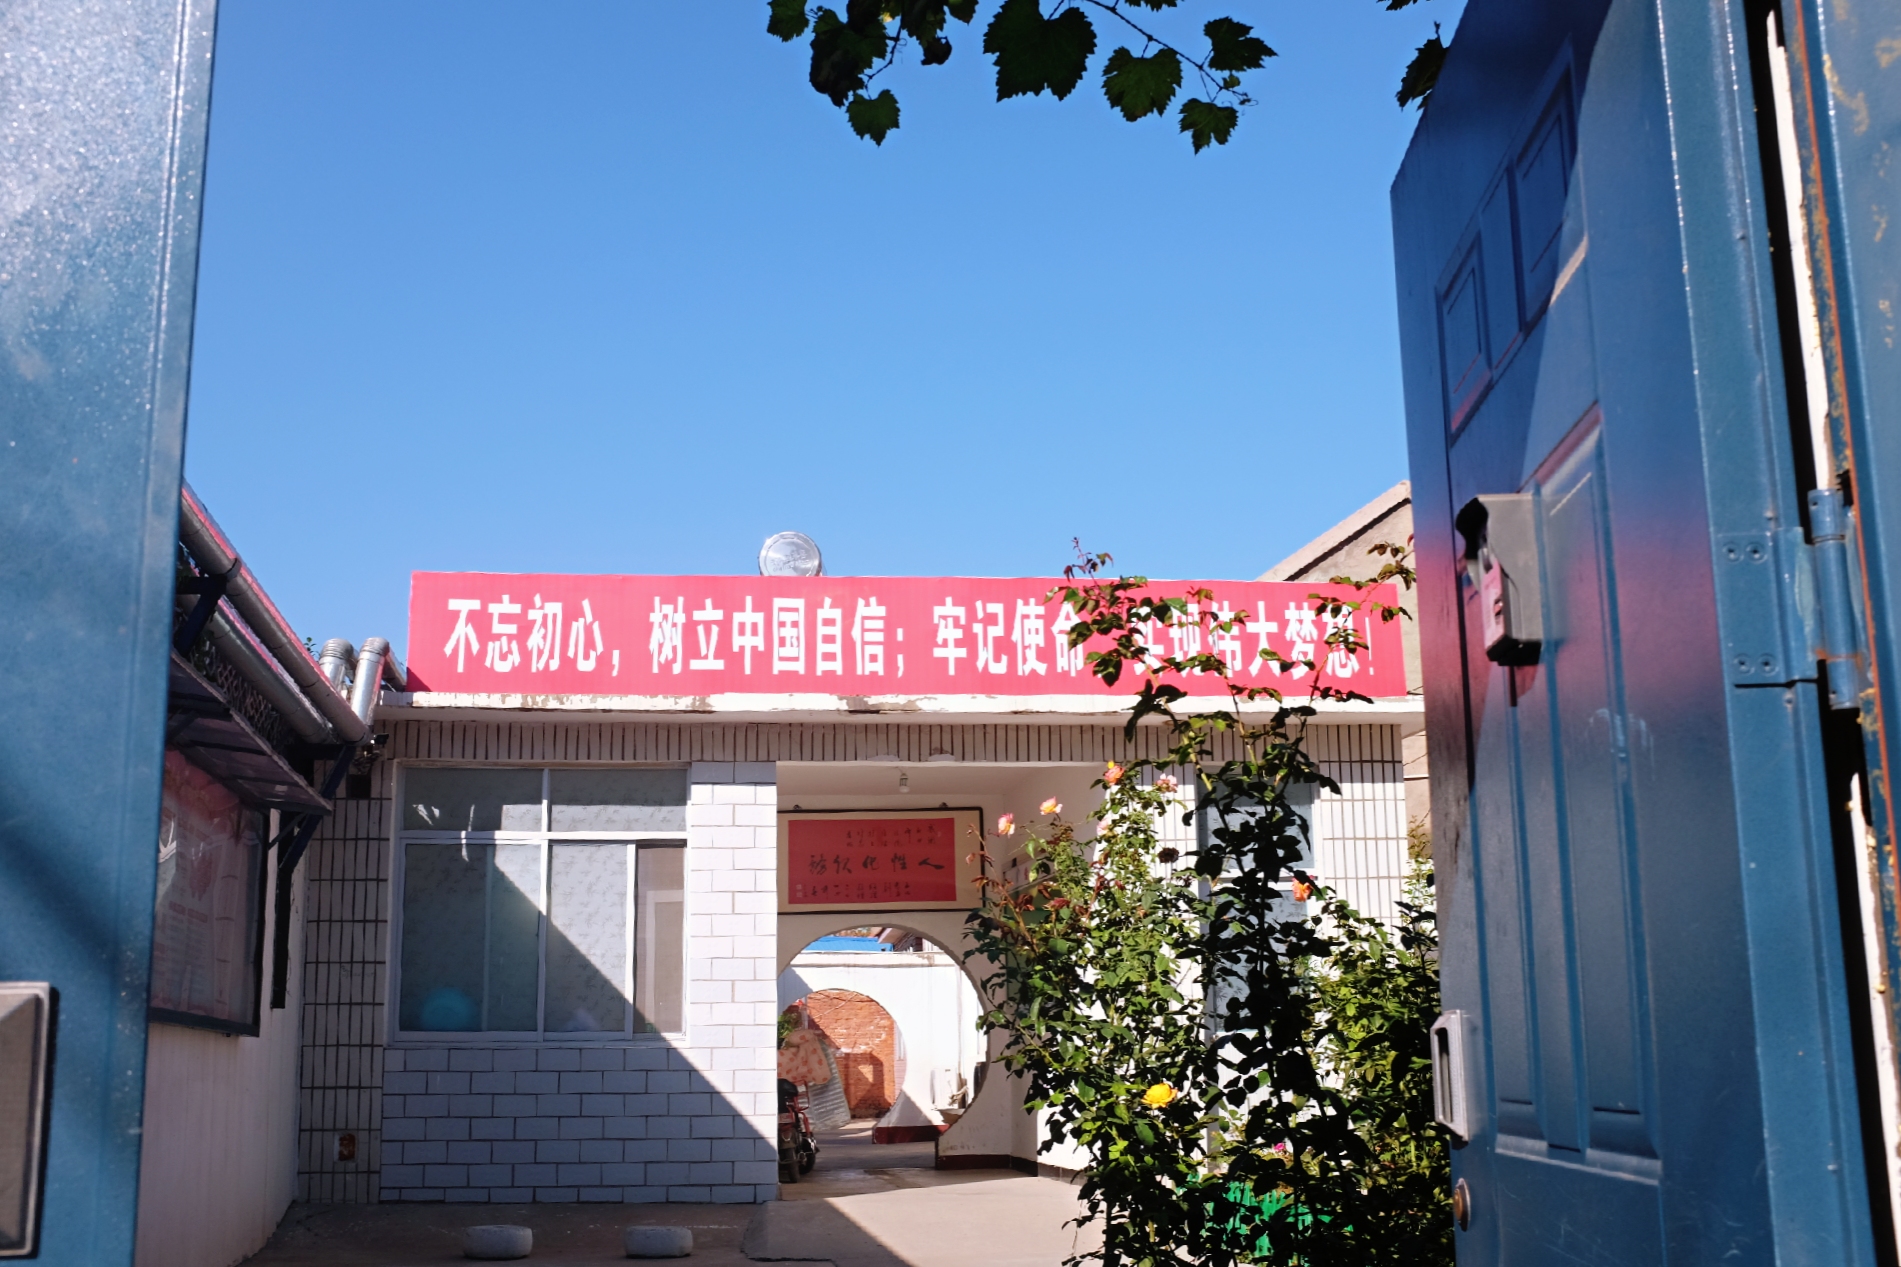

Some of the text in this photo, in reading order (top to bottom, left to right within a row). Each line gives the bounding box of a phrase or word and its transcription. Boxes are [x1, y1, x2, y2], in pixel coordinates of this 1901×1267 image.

[444, 594, 1374, 679] 不忘初心，树立中国自信；牢记使命实现伟大梦想！
